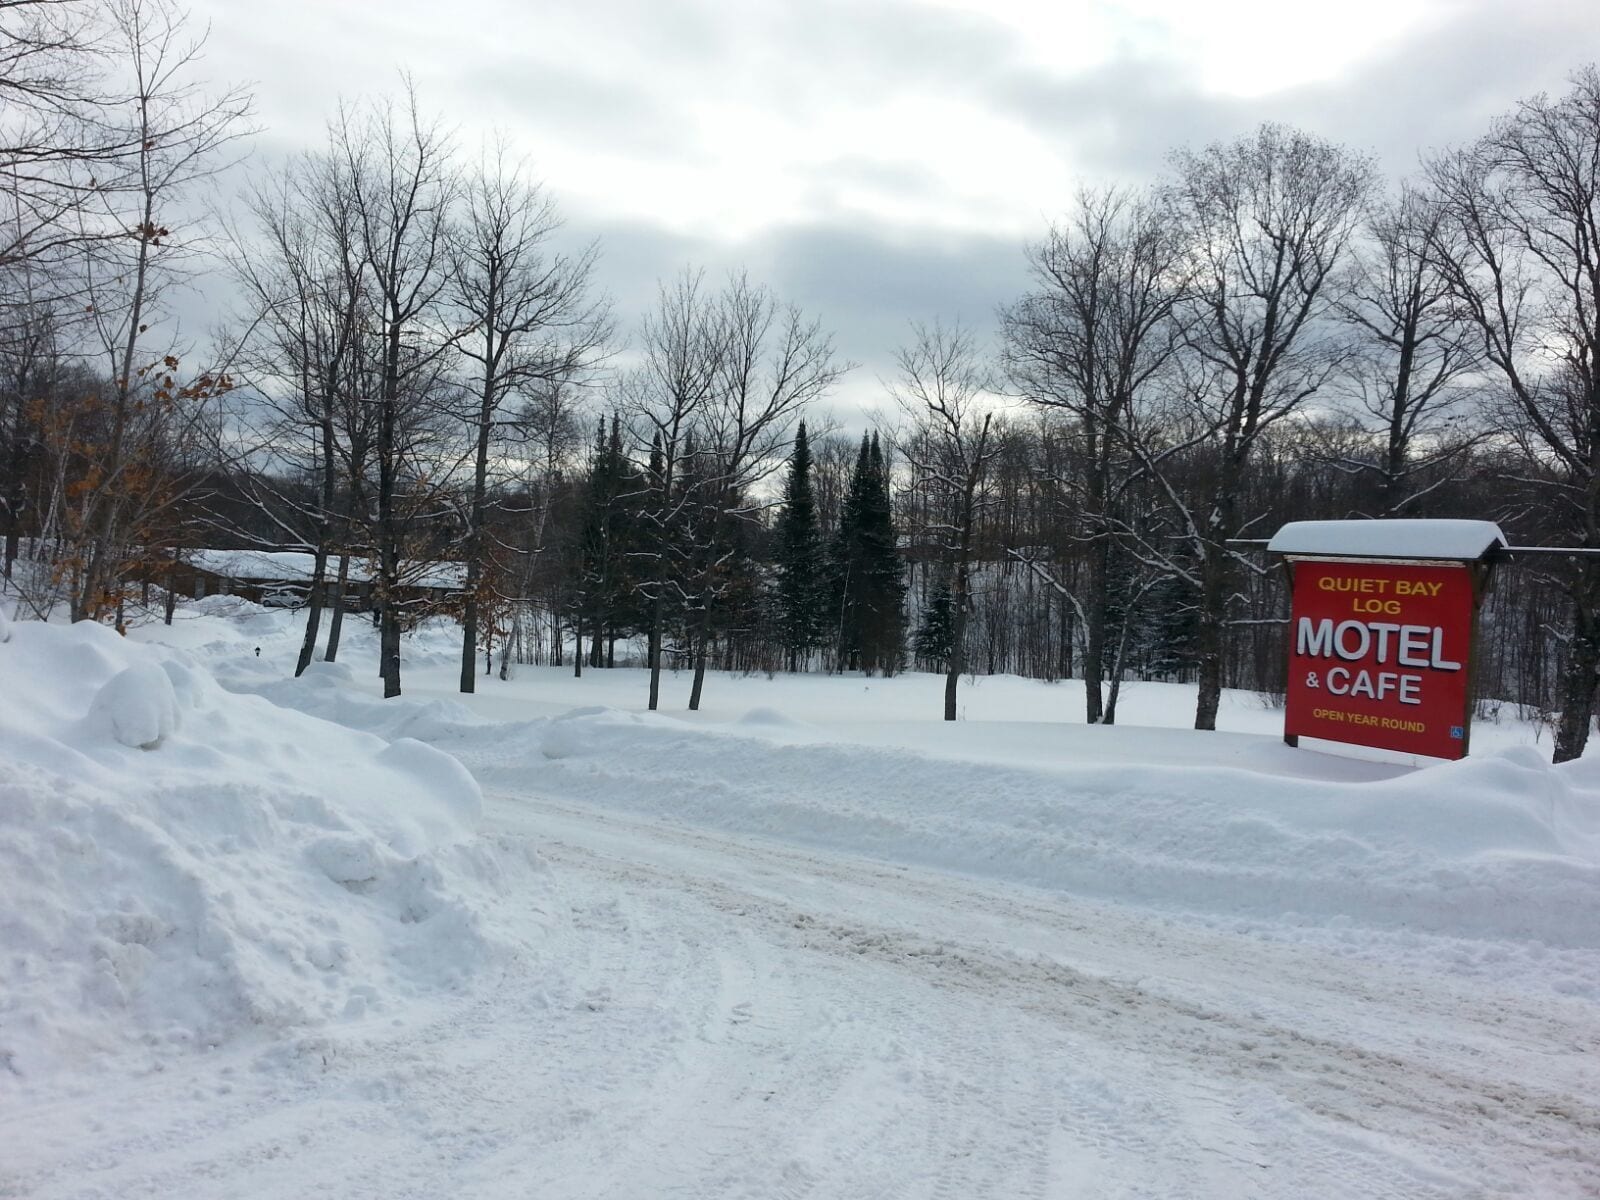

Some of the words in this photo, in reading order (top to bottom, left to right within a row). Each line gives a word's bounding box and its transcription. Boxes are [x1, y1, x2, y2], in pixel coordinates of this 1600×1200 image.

[1318, 576, 1390, 593] QUIET
[1395, 580, 1443, 596] BAY
[1353, 598, 1401, 615] LOG
[1297, 617, 1462, 670] MOTEL
[1306, 671, 1320, 689] &
[1326, 667, 1422, 705] CAFE
[1313, 708, 1344, 722] OPEN
[1347, 713, 1379, 727] YEAR
[1381, 718, 1425, 733] ROUND
